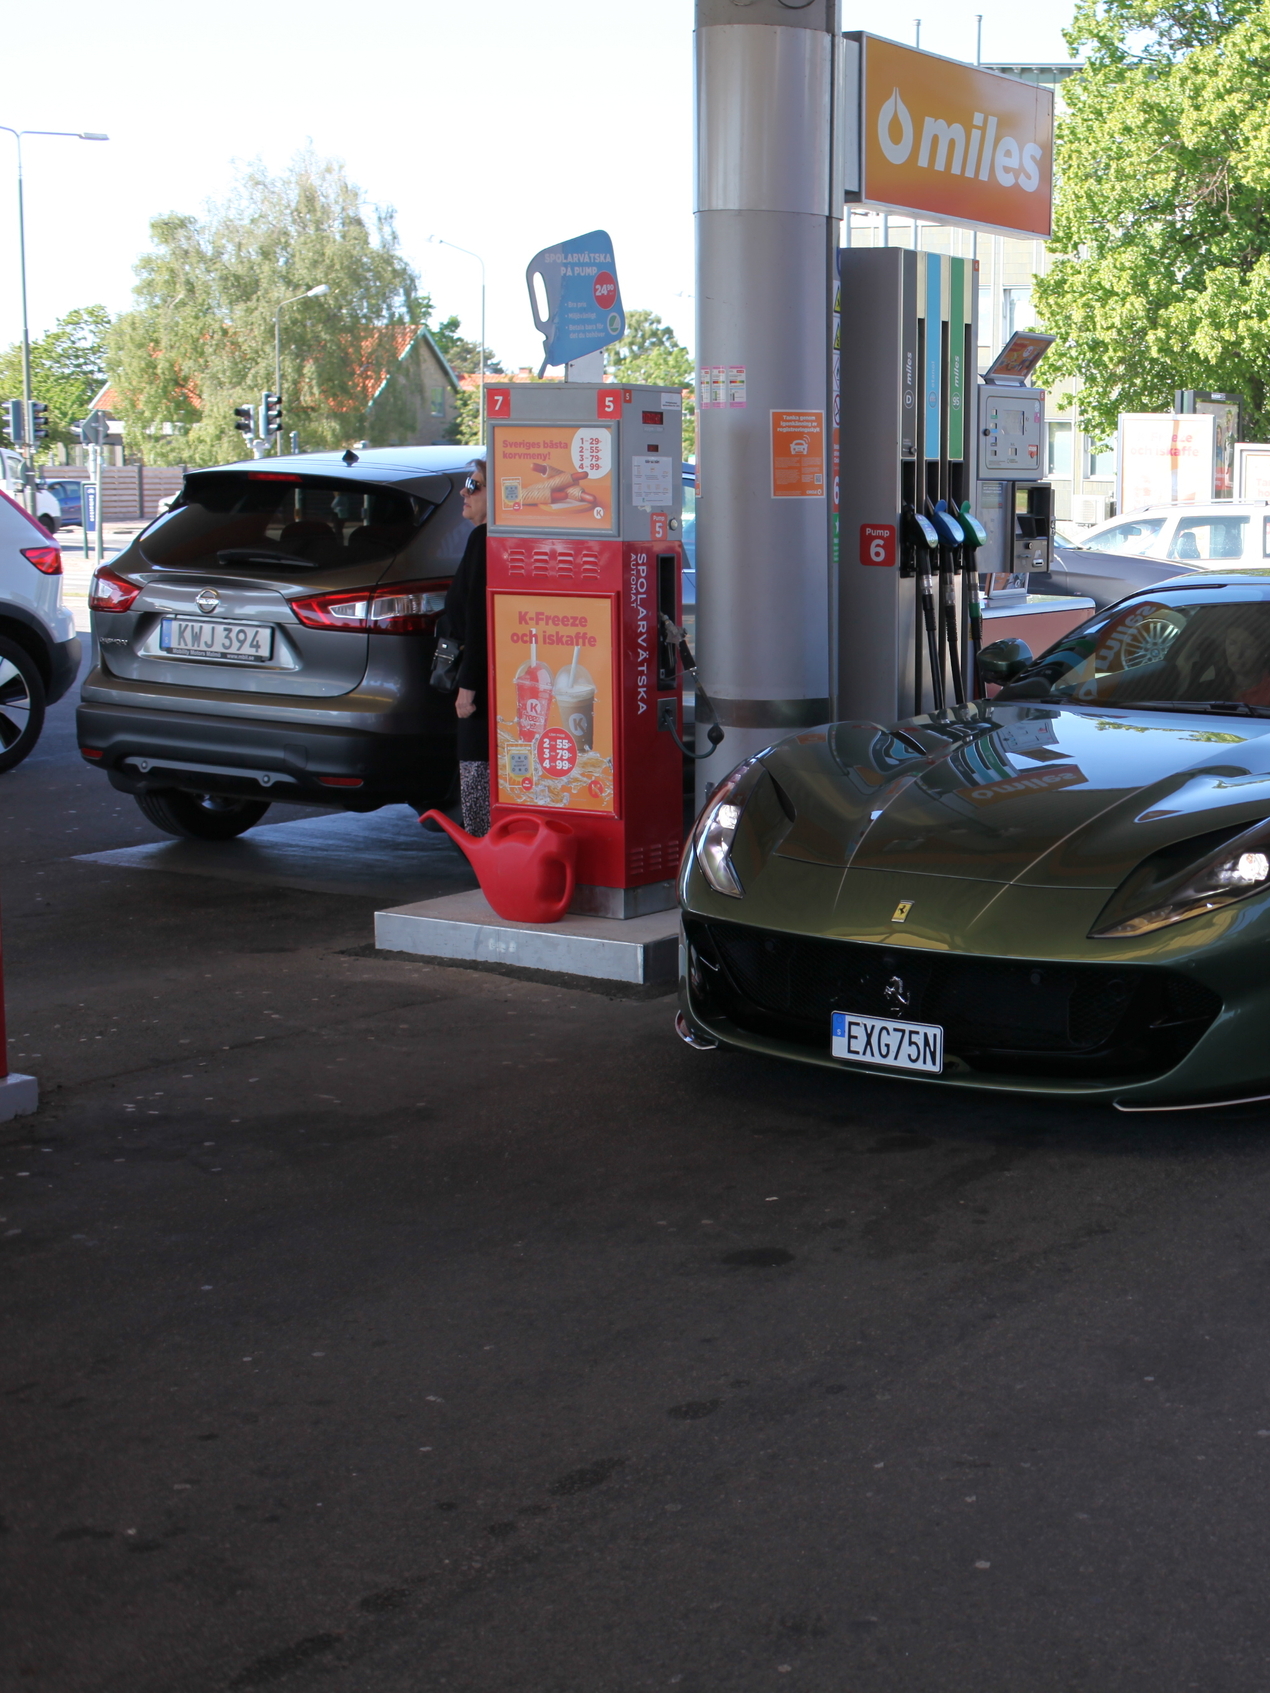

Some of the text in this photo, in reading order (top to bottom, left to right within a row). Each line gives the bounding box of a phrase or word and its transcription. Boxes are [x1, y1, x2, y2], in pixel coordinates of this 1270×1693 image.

[917, 111, 1043, 192] miles
[544, 252, 612, 263] SPOLARVÄTSKA
[561, 265, 597, 276] PÅ PUMP
[494, 396, 503, 411] 7
[604, 397, 614, 412] 5
[905, 395, 912, 404] D
[502, 440, 568, 450] Sveriges bästa
[1131, 445, 1199, 457] och iskaffe
[502, 451, 551, 462] korvmeny!
[653, 514, 665, 522] Pump
[655, 523, 662, 538] 5
[866, 528, 890, 537] Pump
[870, 539, 886, 562] 6
[518, 611, 588, 628] K-Freeze
[177, 623, 262, 653] KWJ 394
[510, 630, 597, 647] och iskaffe
[637, 553, 649, 715] SPOLARVÄTSKA
[190, 649, 206, 657] Motors
[847, 1021, 938, 1067] EXG75N
